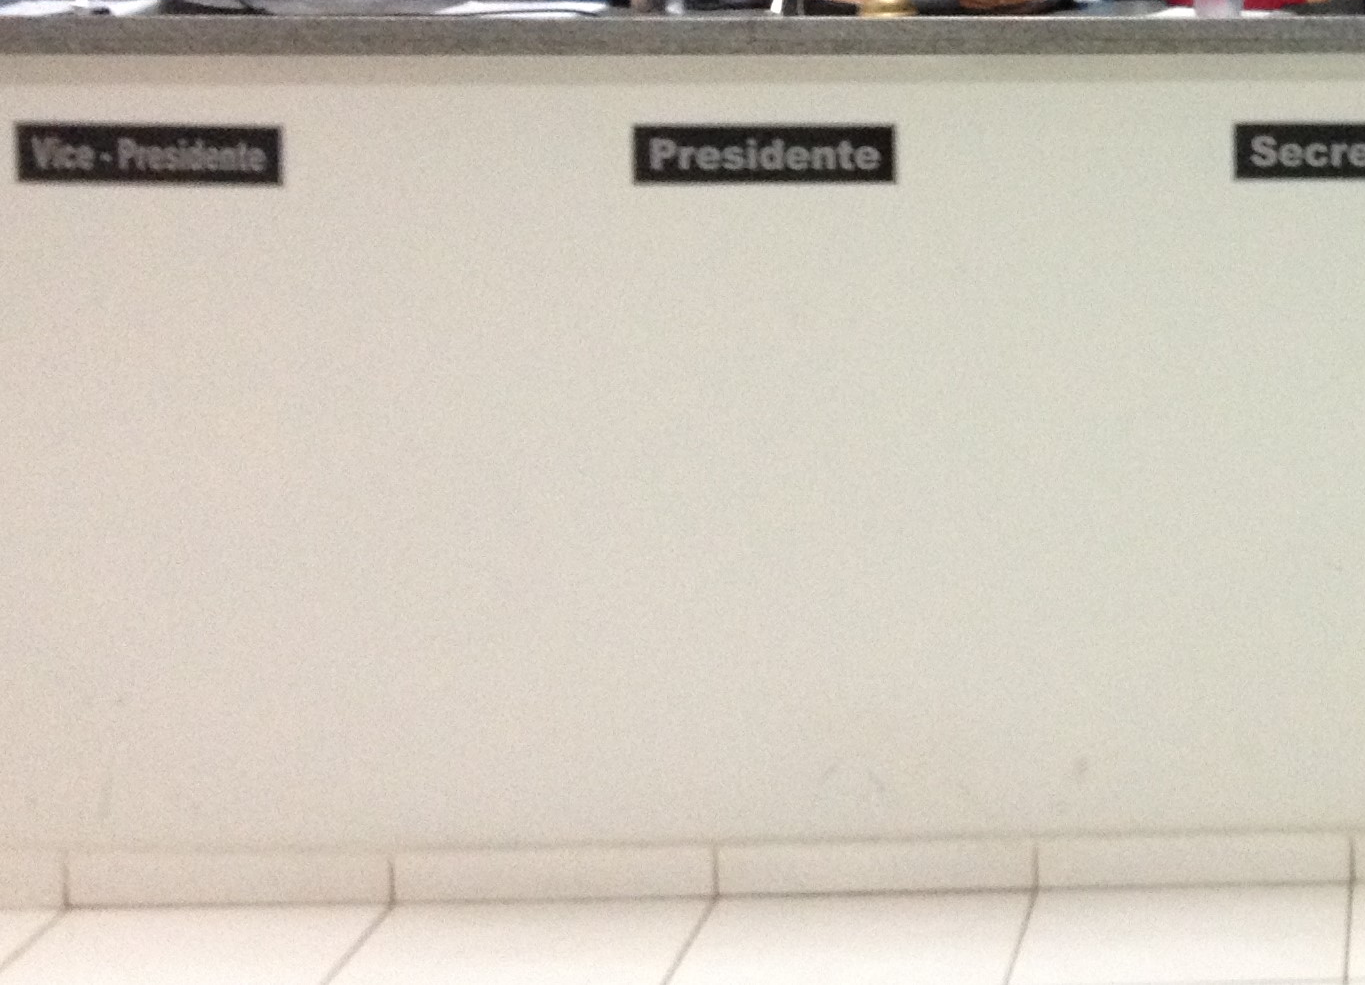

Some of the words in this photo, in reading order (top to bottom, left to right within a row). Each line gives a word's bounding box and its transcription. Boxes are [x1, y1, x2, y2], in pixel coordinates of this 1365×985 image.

[30, 135, 95, 171] Vice
[117, 137, 268, 172] Presidente
[649, 137, 882, 171] Presidente
